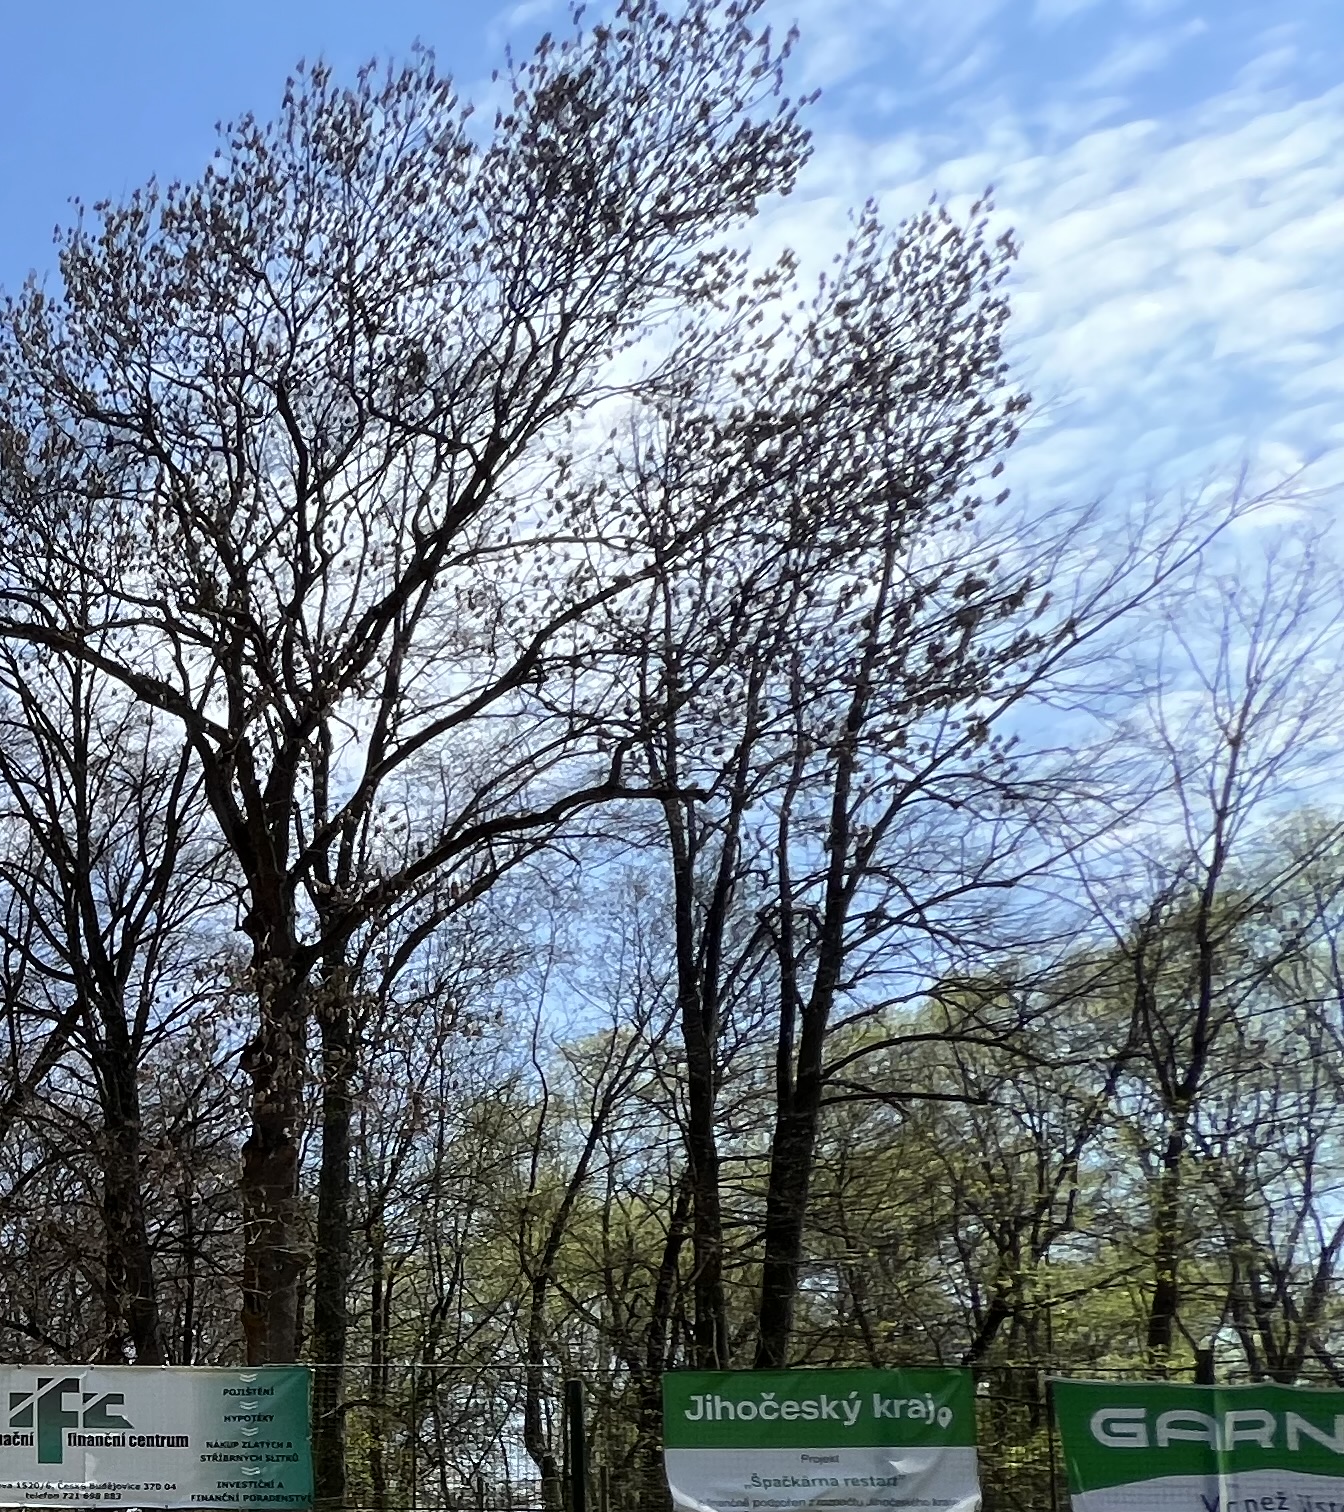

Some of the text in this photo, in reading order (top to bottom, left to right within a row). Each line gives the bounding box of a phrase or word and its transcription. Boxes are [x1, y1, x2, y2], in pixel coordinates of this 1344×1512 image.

[685, 1391, 935, 1426] Jihočeský kraj
[68, 1432, 125, 1447] finanční
[129, 1434, 189, 1447] centrum
[801, 1454, 840, 1465] Projekt
[1244, 1491, 1289, 1512] než
